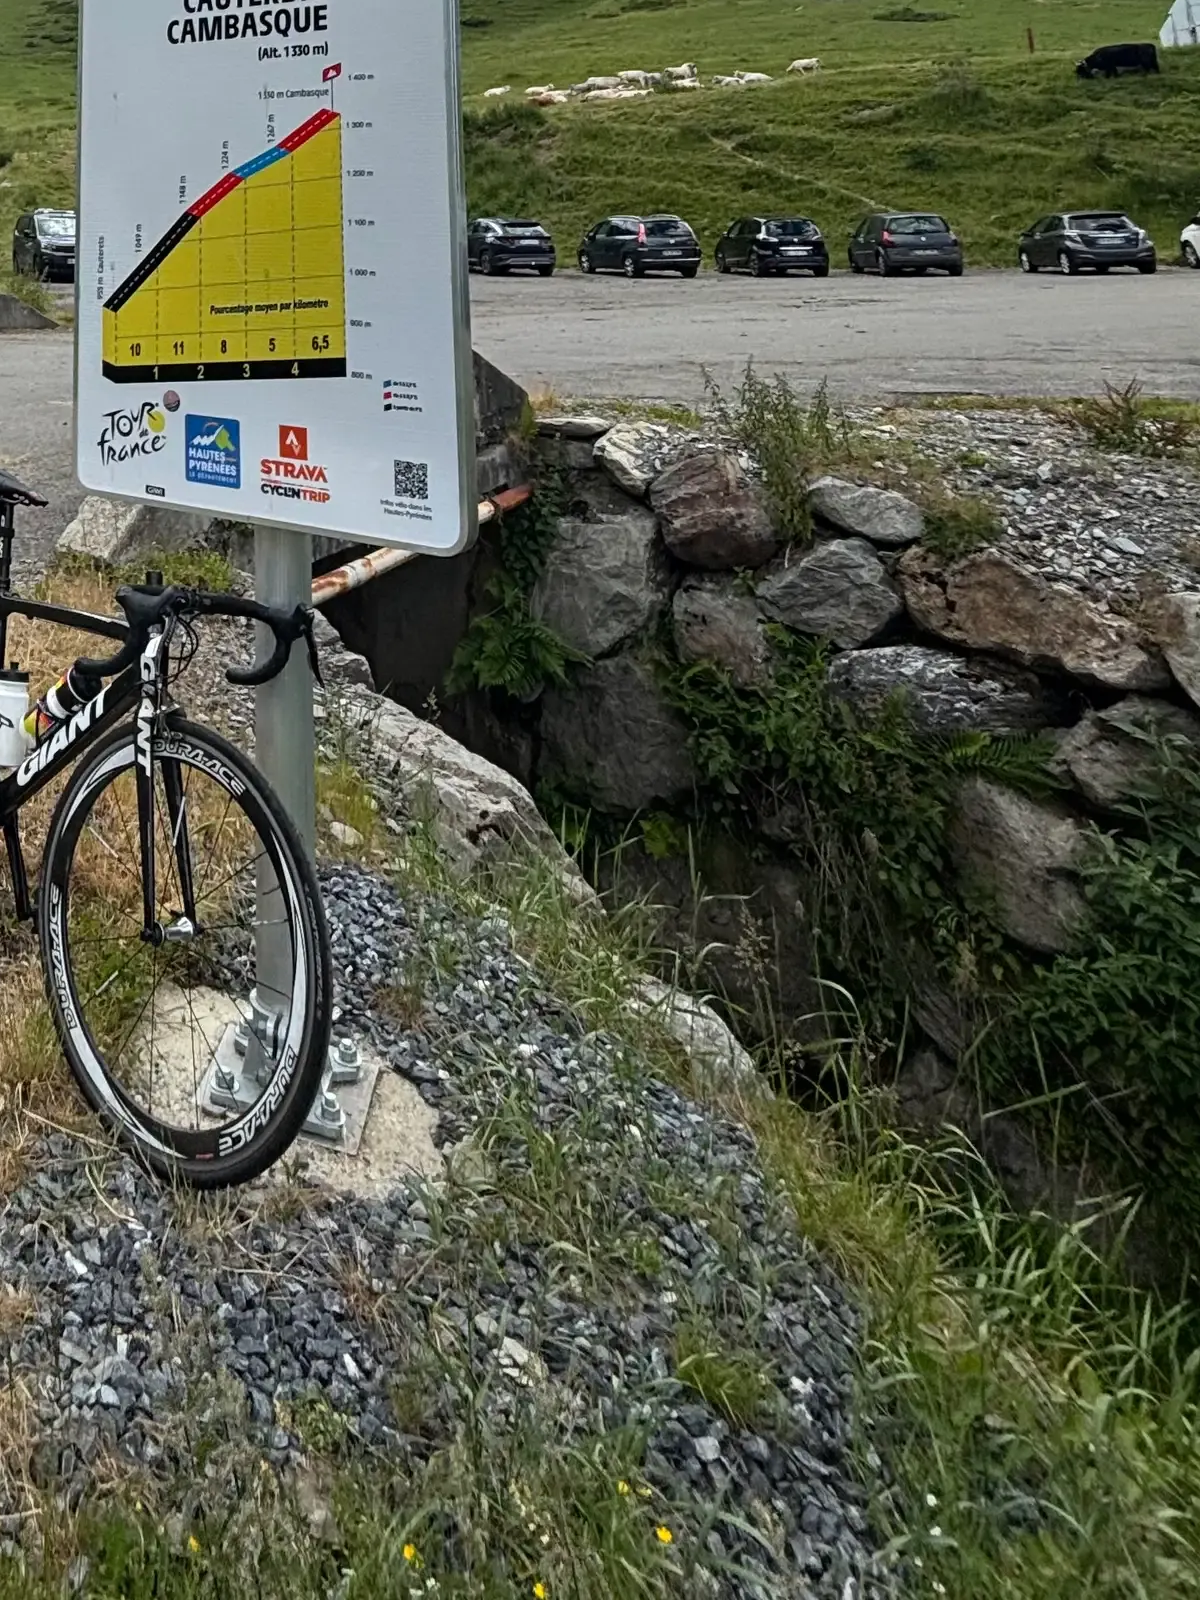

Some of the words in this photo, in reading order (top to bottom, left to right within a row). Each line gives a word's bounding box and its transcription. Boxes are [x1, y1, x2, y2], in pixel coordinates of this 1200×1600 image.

[167, 5, 328, 45] CAMBASQUE
[258, 46, 282, 61] (Alt.
[129, 343, 141, 357] 10
[173, 341, 185, 356] 11
[220, 339, 228, 354] 8
[268, 338, 276, 352] 5
[311, 335, 329, 353] 6,5
[153, 366, 159, 380] 1
[197, 365, 204, 379] 2
[243, 363, 250, 378] 3
[291, 361, 299, 376] 4
[188, 447, 226, 463] HAUTES
[188, 460, 237, 477] PYRÉNÉES
[260, 458, 328, 483] STRAVA
[17, 682, 113, 787] GIANT
[153, 739, 248, 796] DURA-ACE
